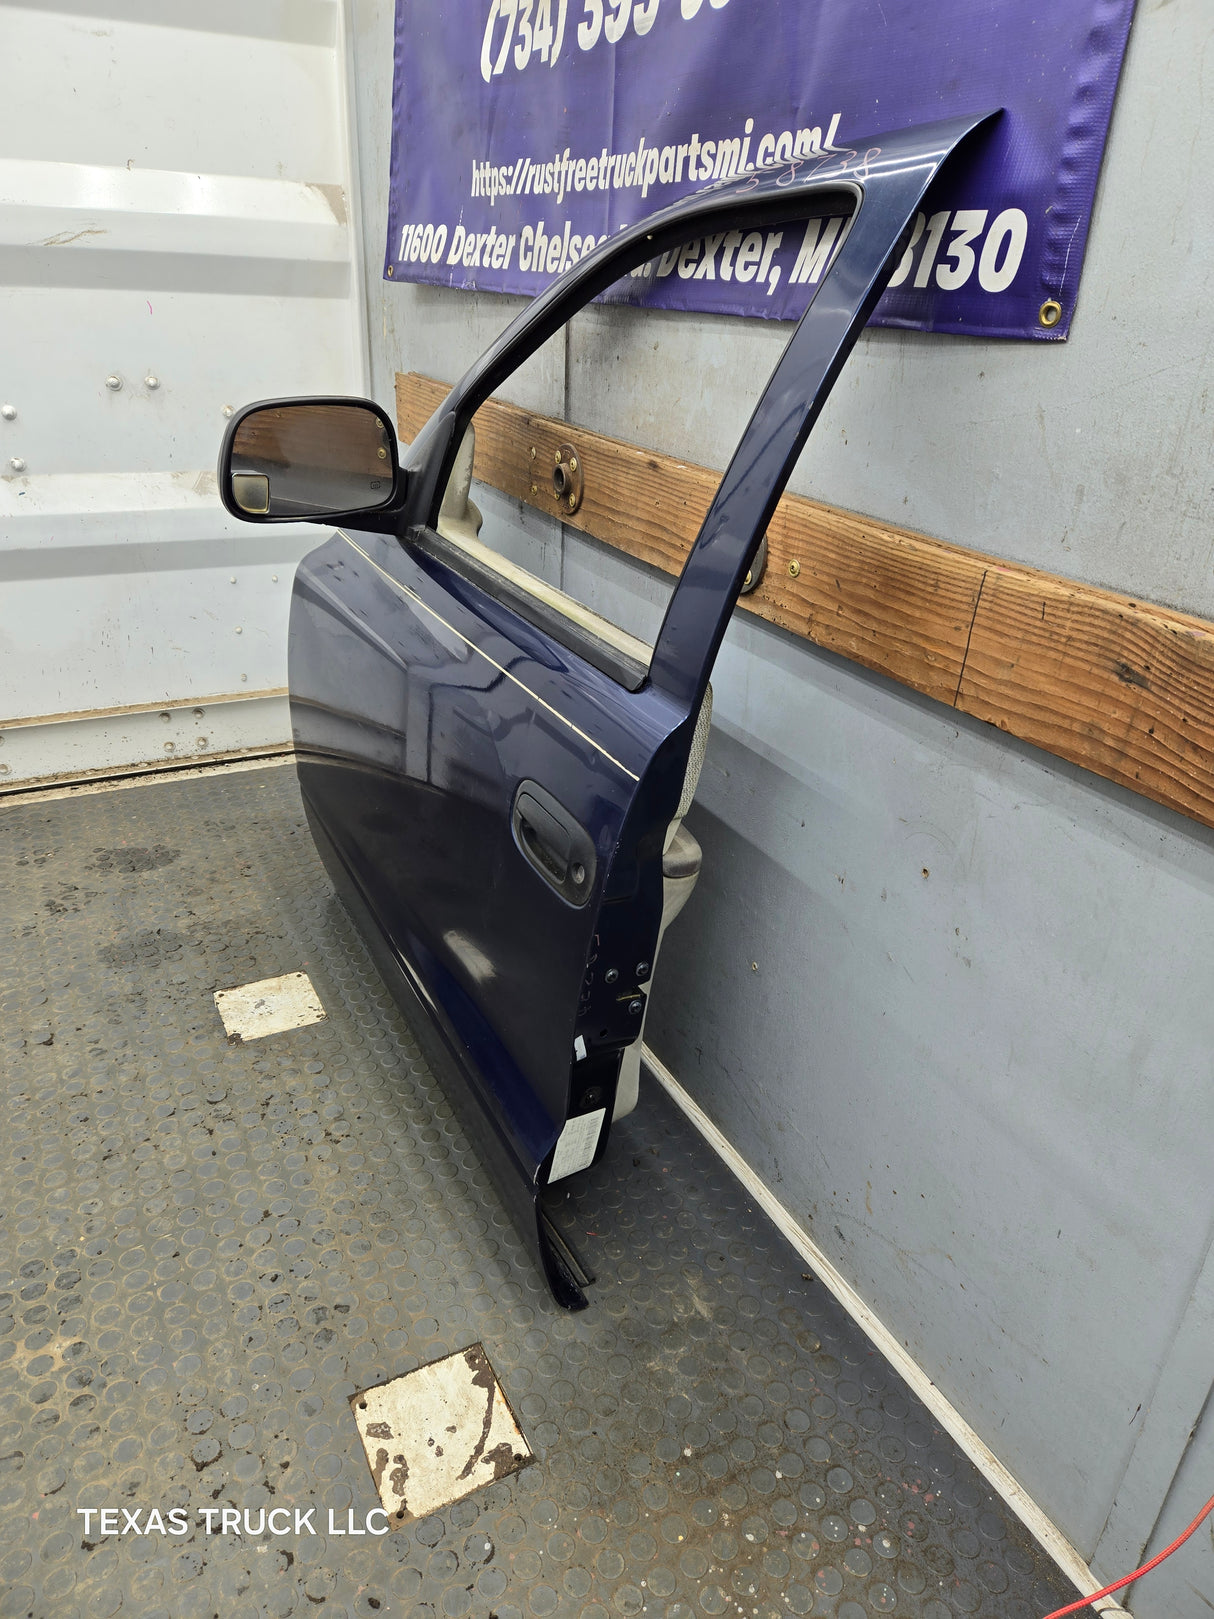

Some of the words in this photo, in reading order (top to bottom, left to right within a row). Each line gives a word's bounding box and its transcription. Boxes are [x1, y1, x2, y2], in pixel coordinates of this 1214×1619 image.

[471, 113, 842, 206] https://rustfreetruckpartsmi.com/
[398, 223, 448, 264] 11600
[446, 225, 516, 269] Dexter
[519, 220, 611, 273] Chelse
